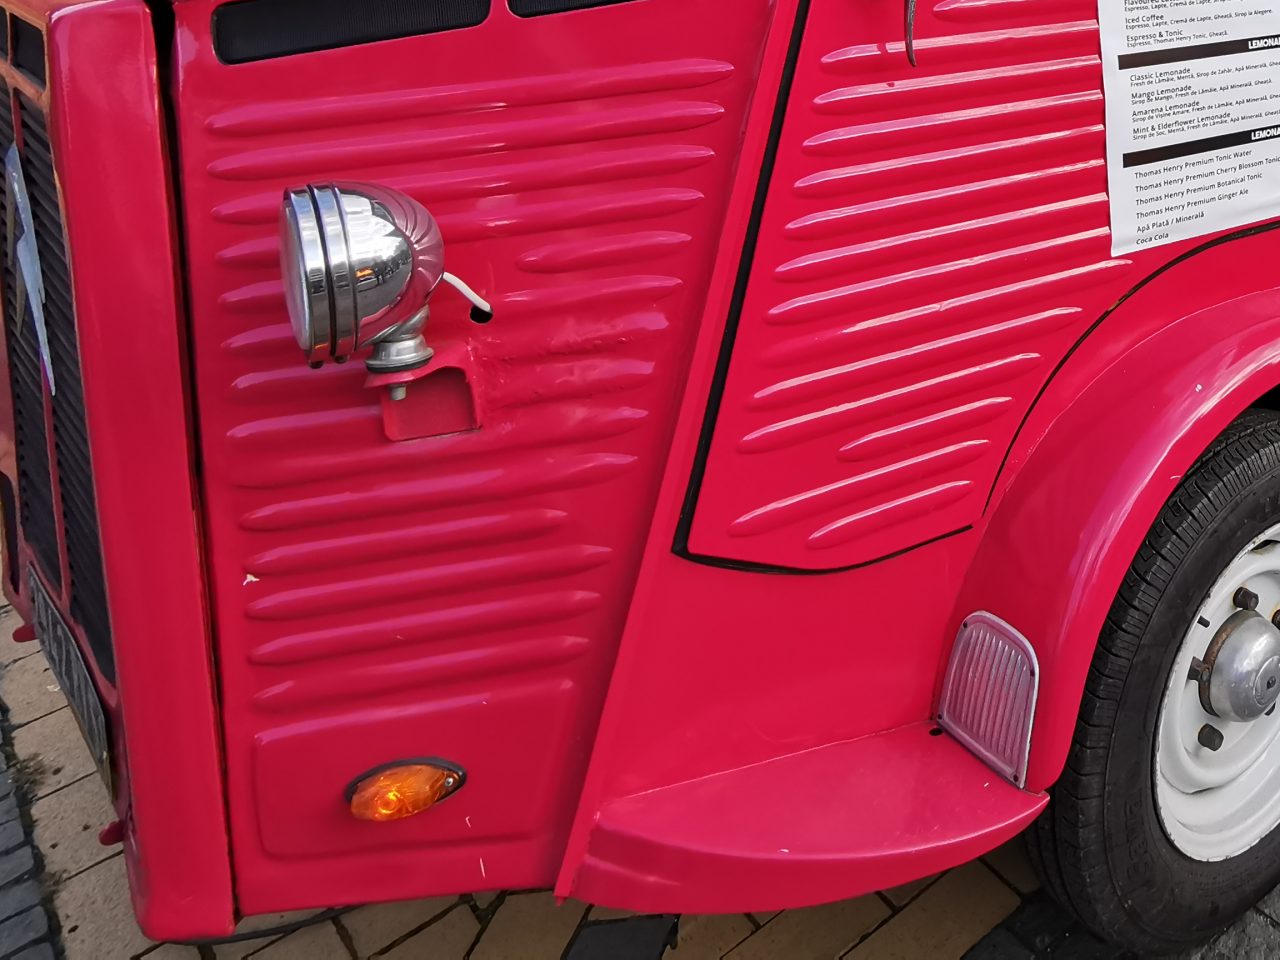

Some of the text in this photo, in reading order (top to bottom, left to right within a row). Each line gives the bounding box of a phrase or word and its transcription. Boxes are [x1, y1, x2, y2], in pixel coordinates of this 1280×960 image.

[1127, 34, 1156, 42] Espresso
[1130, 68, 1190, 82] Classic Lemonade
[1157, 85, 1192, 96] Lemonade
[1132, 101, 1199, 117] Amarena Lemonade
[1133, 126, 1149, 135] Mint
[1158, 120, 1195, 130] Elderflower
[1197, 112, 1230, 123] Lemonade
[1135, 169, 1161, 179] Thomas
[1163, 165, 1183, 173] Henry
[1185, 159, 1214, 169] Premium
[1216, 154, 1232, 162] Tonic
[1136, 182, 1162, 192] Thomas
[1164, 178, 1184, 186] Henry
[1186, 172, 1214, 182] Premium
[1217, 167, 1237, 175] Cherry
[1239, 161, 1263, 170] Blossom
[1136, 173, 1262, 206] Thomas Henry Premium Botanical Tonic
[1136, 209, 1163, 219] Thomas
[1165, 204, 1185, 213] Henry
[1187, 197, 1216, 208] Premium
[1218, 192, 1238, 201] Ginger
[1154, 233, 1168, 241] Cola
